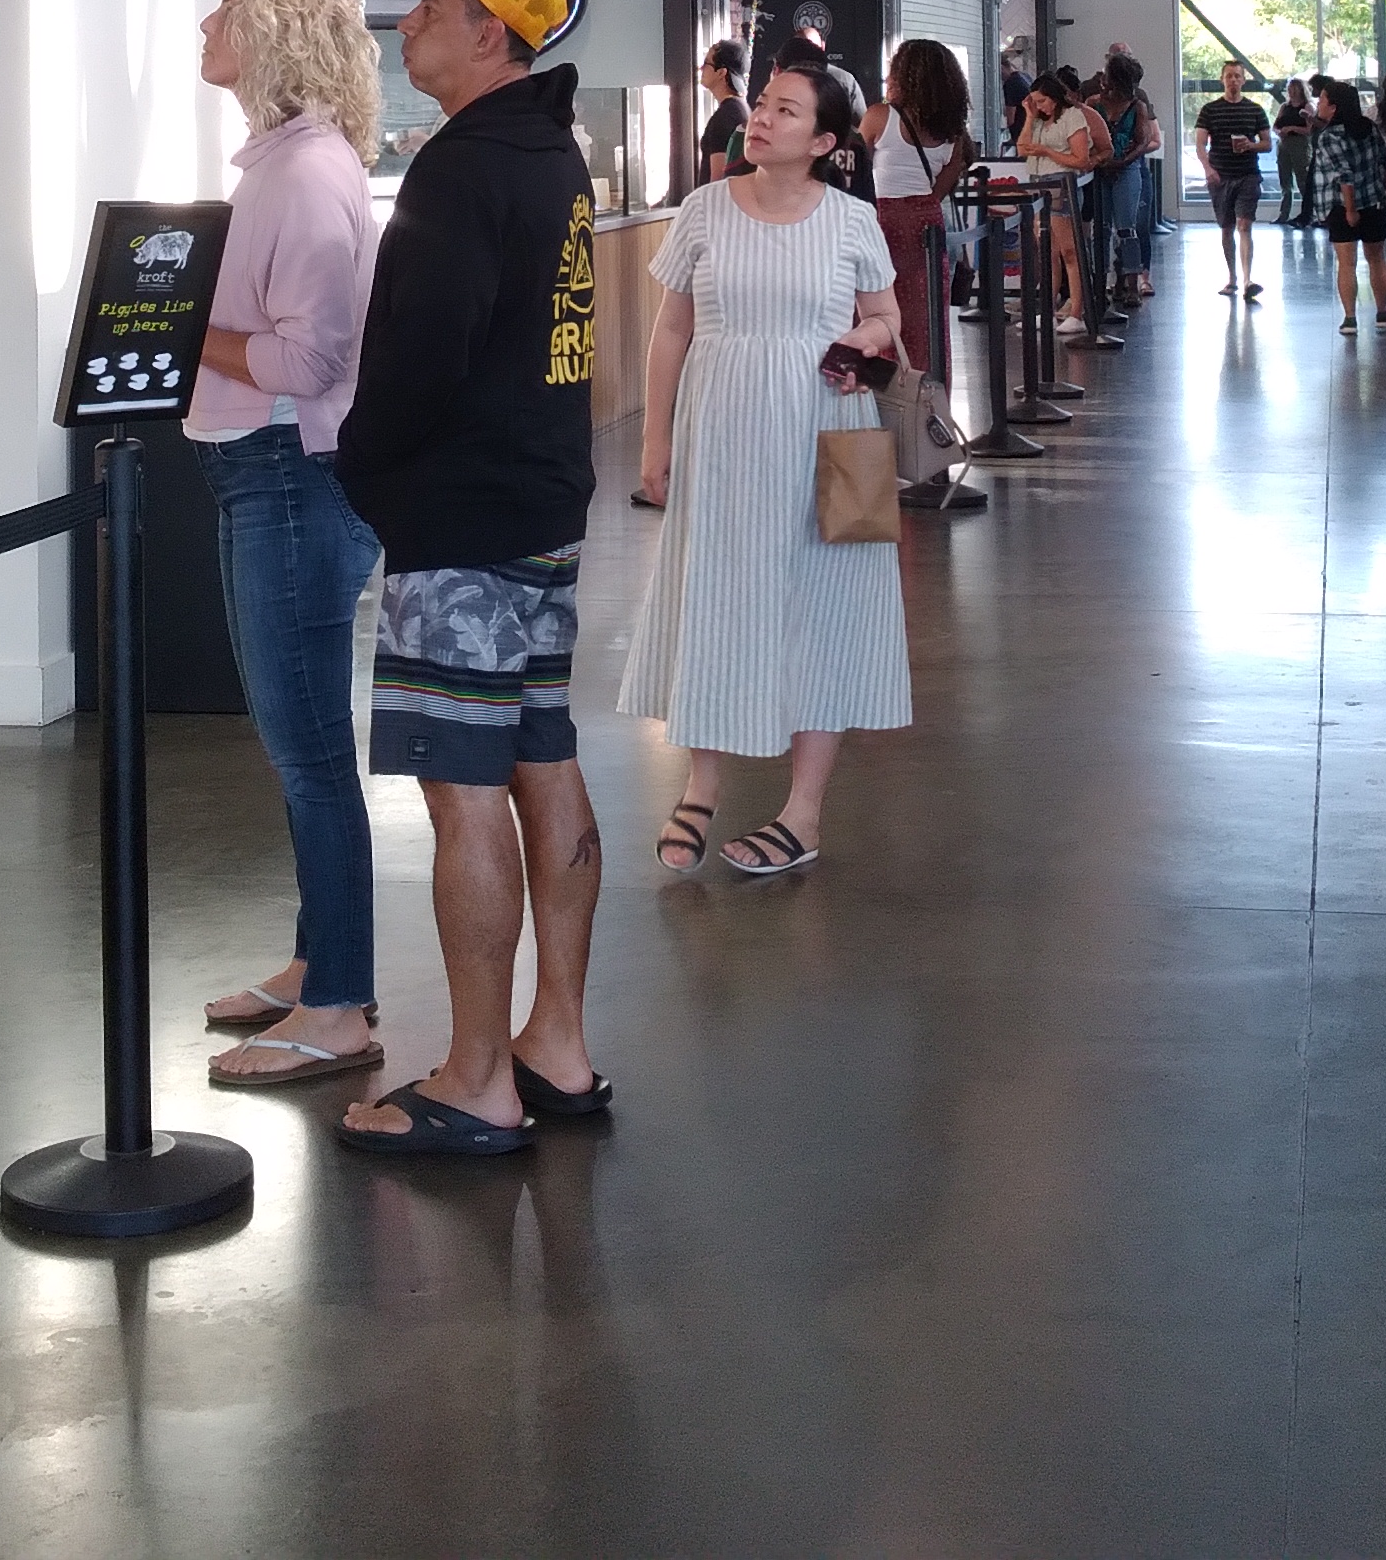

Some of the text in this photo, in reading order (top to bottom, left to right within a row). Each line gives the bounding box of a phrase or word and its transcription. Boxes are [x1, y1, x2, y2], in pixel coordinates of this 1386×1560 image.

[136, 271, 175, 284] kroft
[98, 299, 195, 318] Piggies line
[112, 320, 174, 336] up here.
